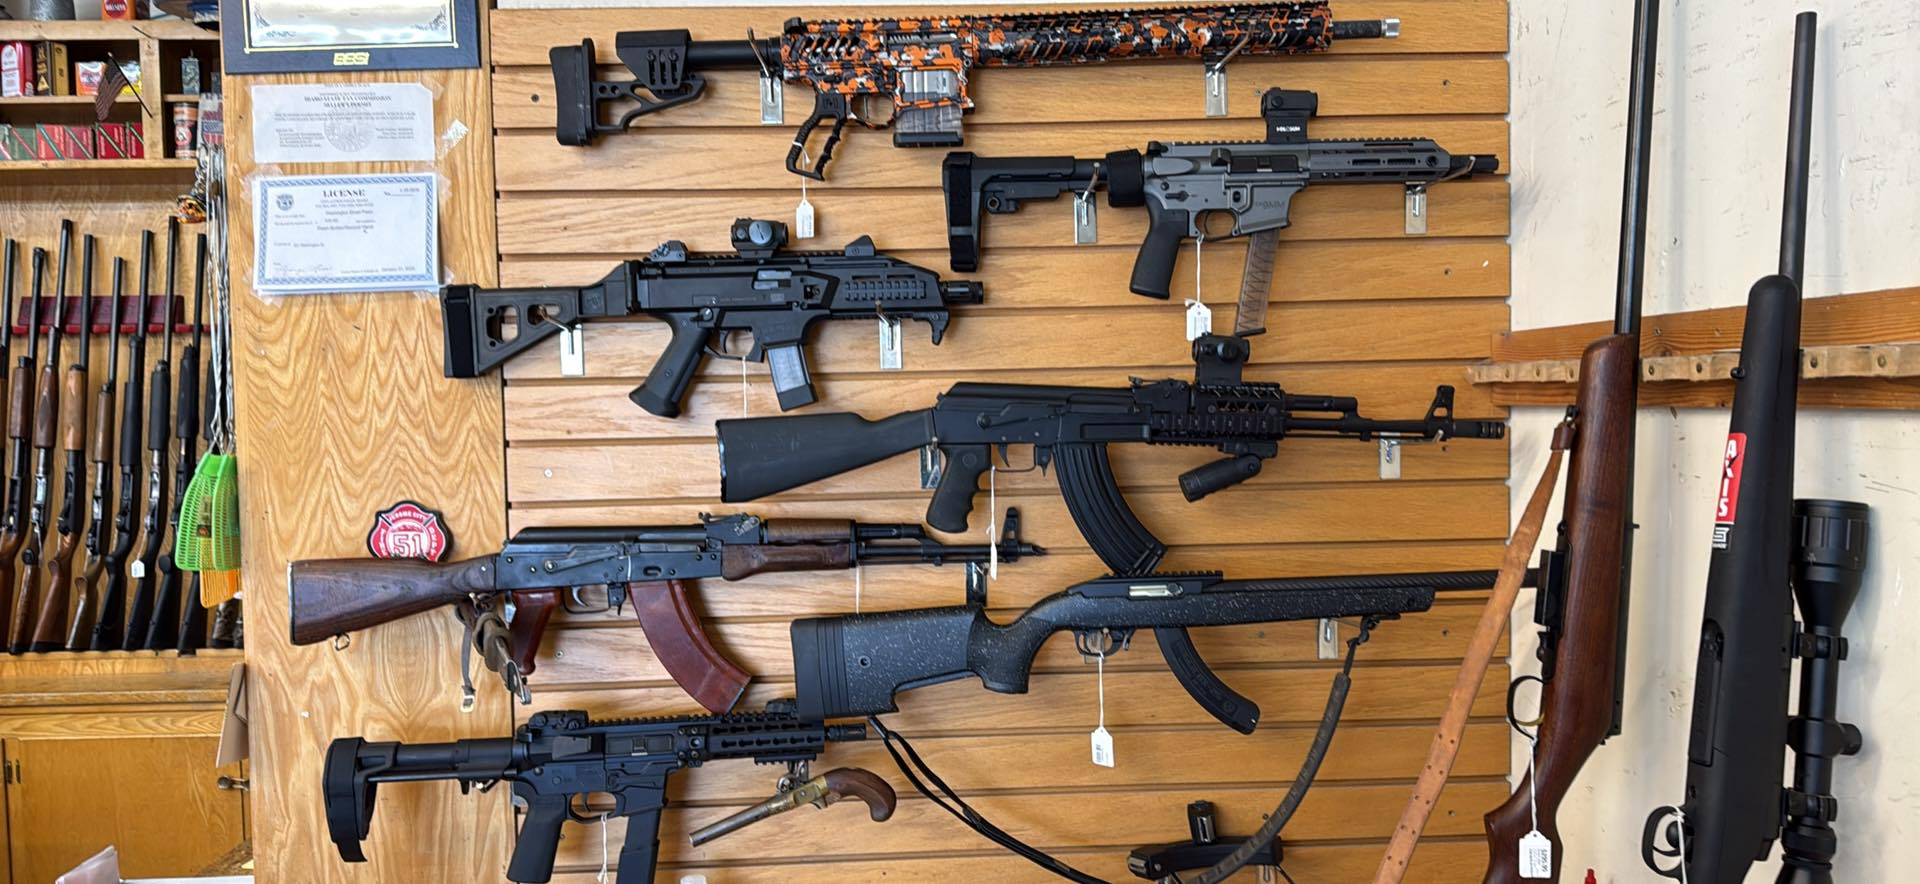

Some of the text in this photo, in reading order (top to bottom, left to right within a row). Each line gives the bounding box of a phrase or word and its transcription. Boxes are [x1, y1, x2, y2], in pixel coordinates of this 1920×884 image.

[323, 189, 366, 198] LICENSE
[1718, 439, 1738, 517] AXIS
[393, 533, 422, 558] 51
